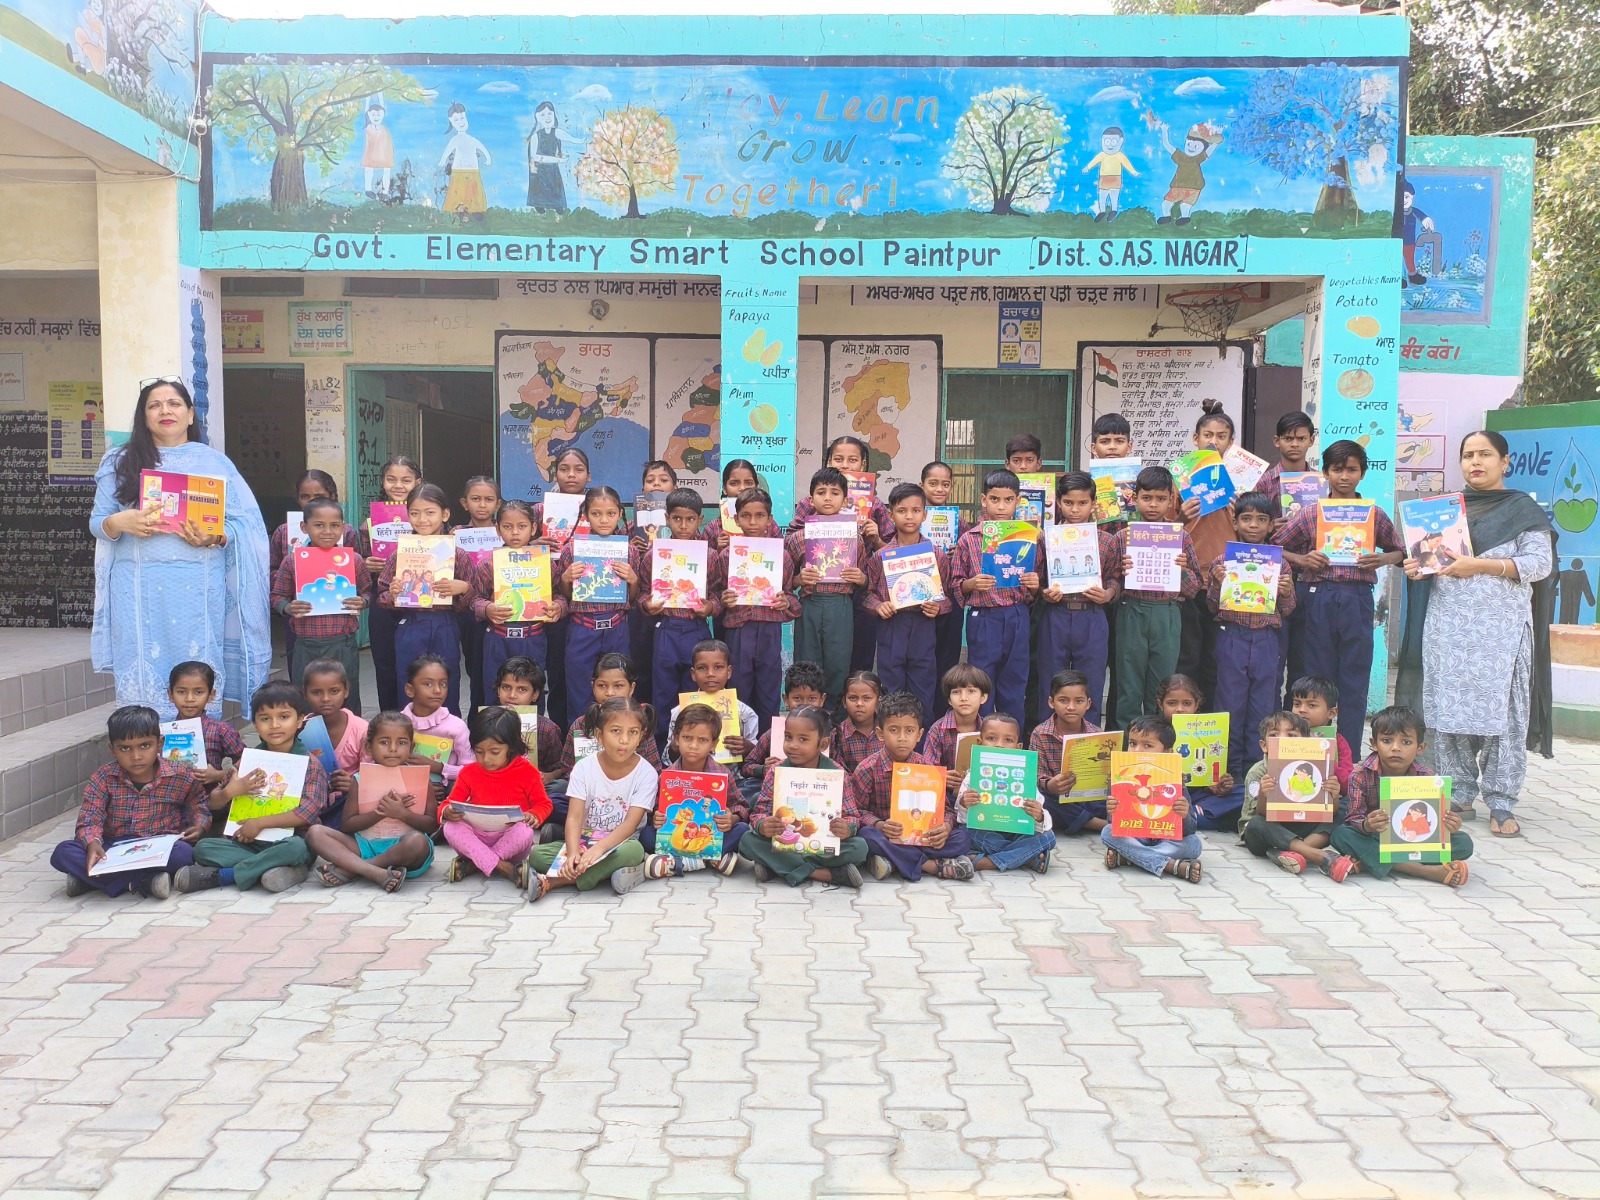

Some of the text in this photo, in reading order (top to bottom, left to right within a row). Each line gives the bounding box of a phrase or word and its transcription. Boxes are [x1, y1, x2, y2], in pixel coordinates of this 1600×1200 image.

[815, 90, 938, 123] Learn
[682, 175, 897, 217] Together!
[314, 233, 396, 259] Govt.
[427, 235, 605, 270] Elementary
[630, 238, 729, 265] Smart
[760, 240, 865, 267] School
[883, 240, 1001, 272] Paintpur
[517, 279, 558, 295] ਕੁਦਰਤ
[564, 280, 590, 294] ਨਾਲ
[725, 288, 787, 298] Fruits Name
[1335, 294, 1378, 308] Potato
[315, 308, 343, 322] ਲਗਾਓ
[729, 309, 770, 324] Papaya
[317, 324, 344, 338] ਬਚਾਓ
[579, 342, 612, 357] ਭਾਰਤ
[1333, 353, 1379, 367] Tomato
[762, 365, 790, 379] ਪਪੀਤਾ
[1356, 401, 1389, 411] ਟਮਾਟਰ
[1324, 422, 1363, 435] Carrot
[1505, 441, 1553, 478] SAVE
[376, 527, 392, 537] हिंदी
[1133, 529, 1150, 541] हिंदी
[657, 548, 673, 560] क
[687, 563, 699, 574] ग
[733, 545, 749, 557] क
[763, 560, 775, 572] ग
[887, 557, 933, 572] हिन्दी सुलेख
